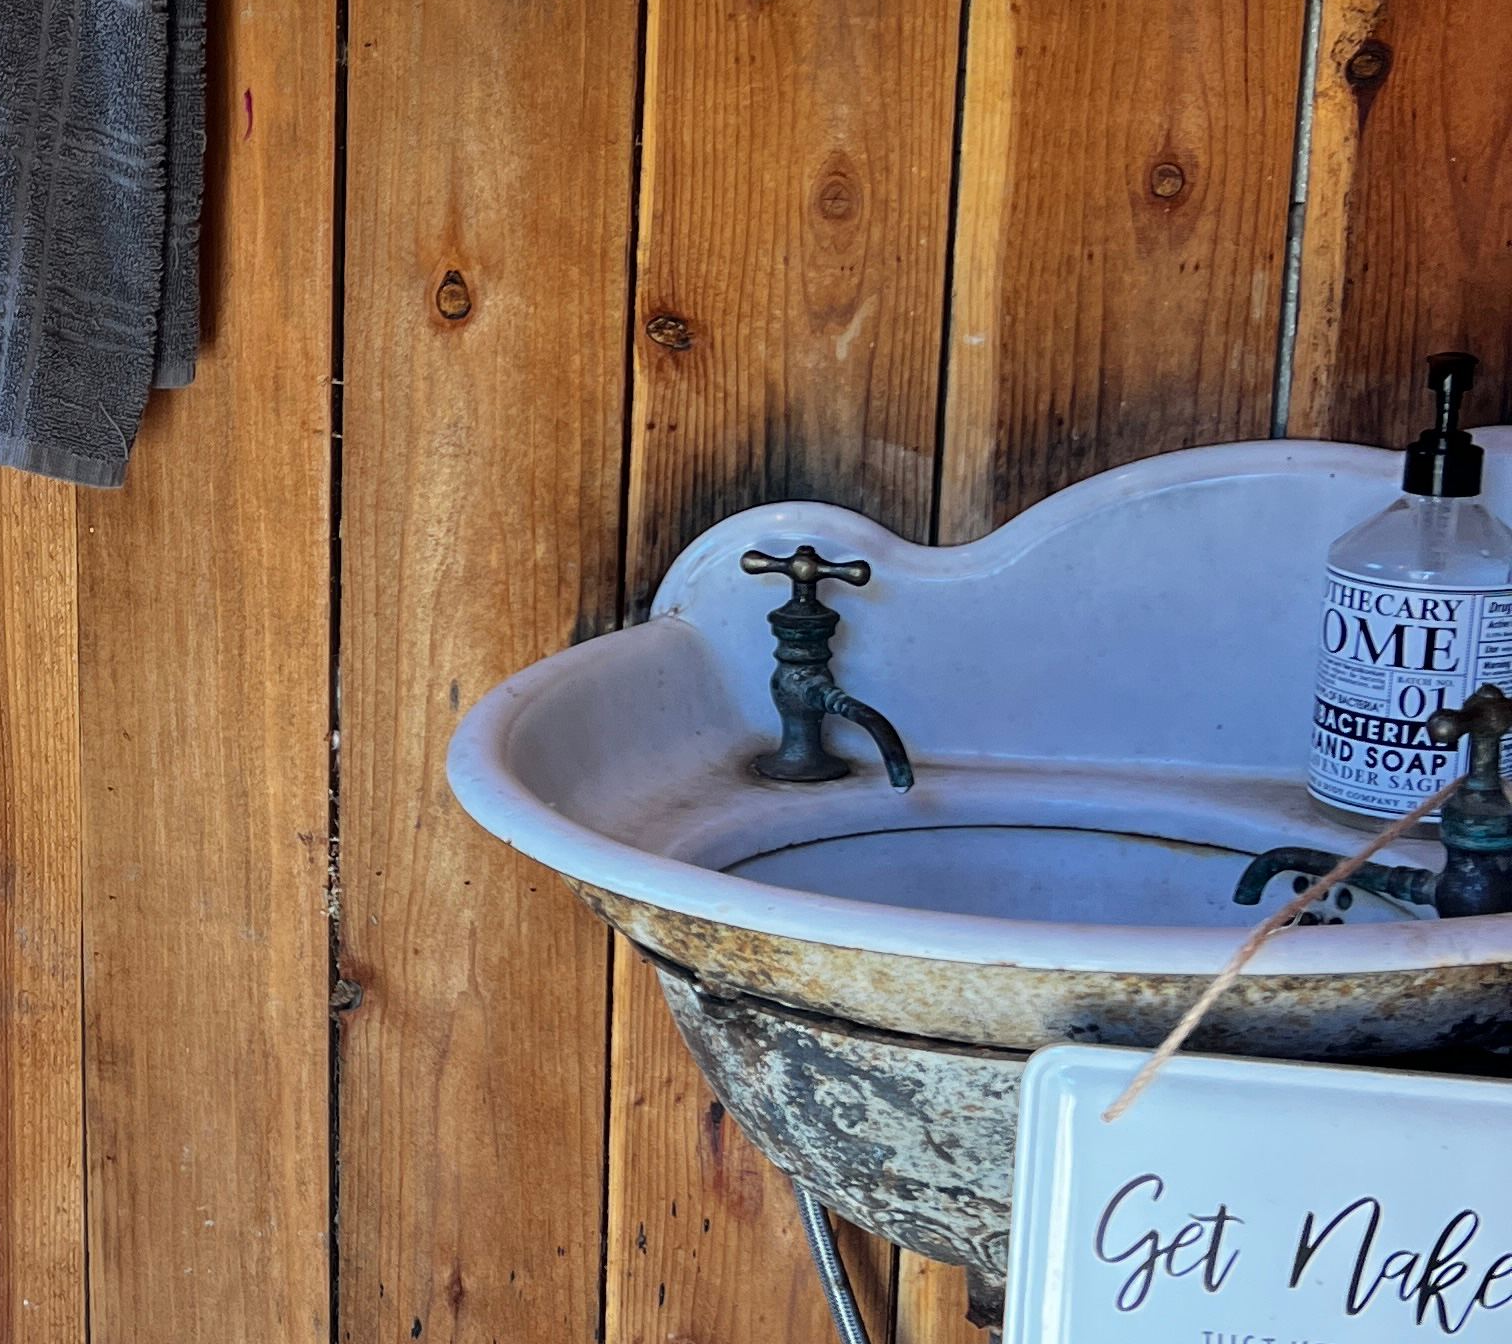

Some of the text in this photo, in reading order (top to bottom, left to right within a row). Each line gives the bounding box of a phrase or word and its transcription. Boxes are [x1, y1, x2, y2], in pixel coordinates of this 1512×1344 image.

[1324, 579, 1464, 622] THECARY
[1323, 608, 1460, 672] OME
[1316, 701, 1447, 747] BACTERIA
[1365, 747, 1447, 775] SOAP
[1094, 1172, 1512, 1335] Get Nake
